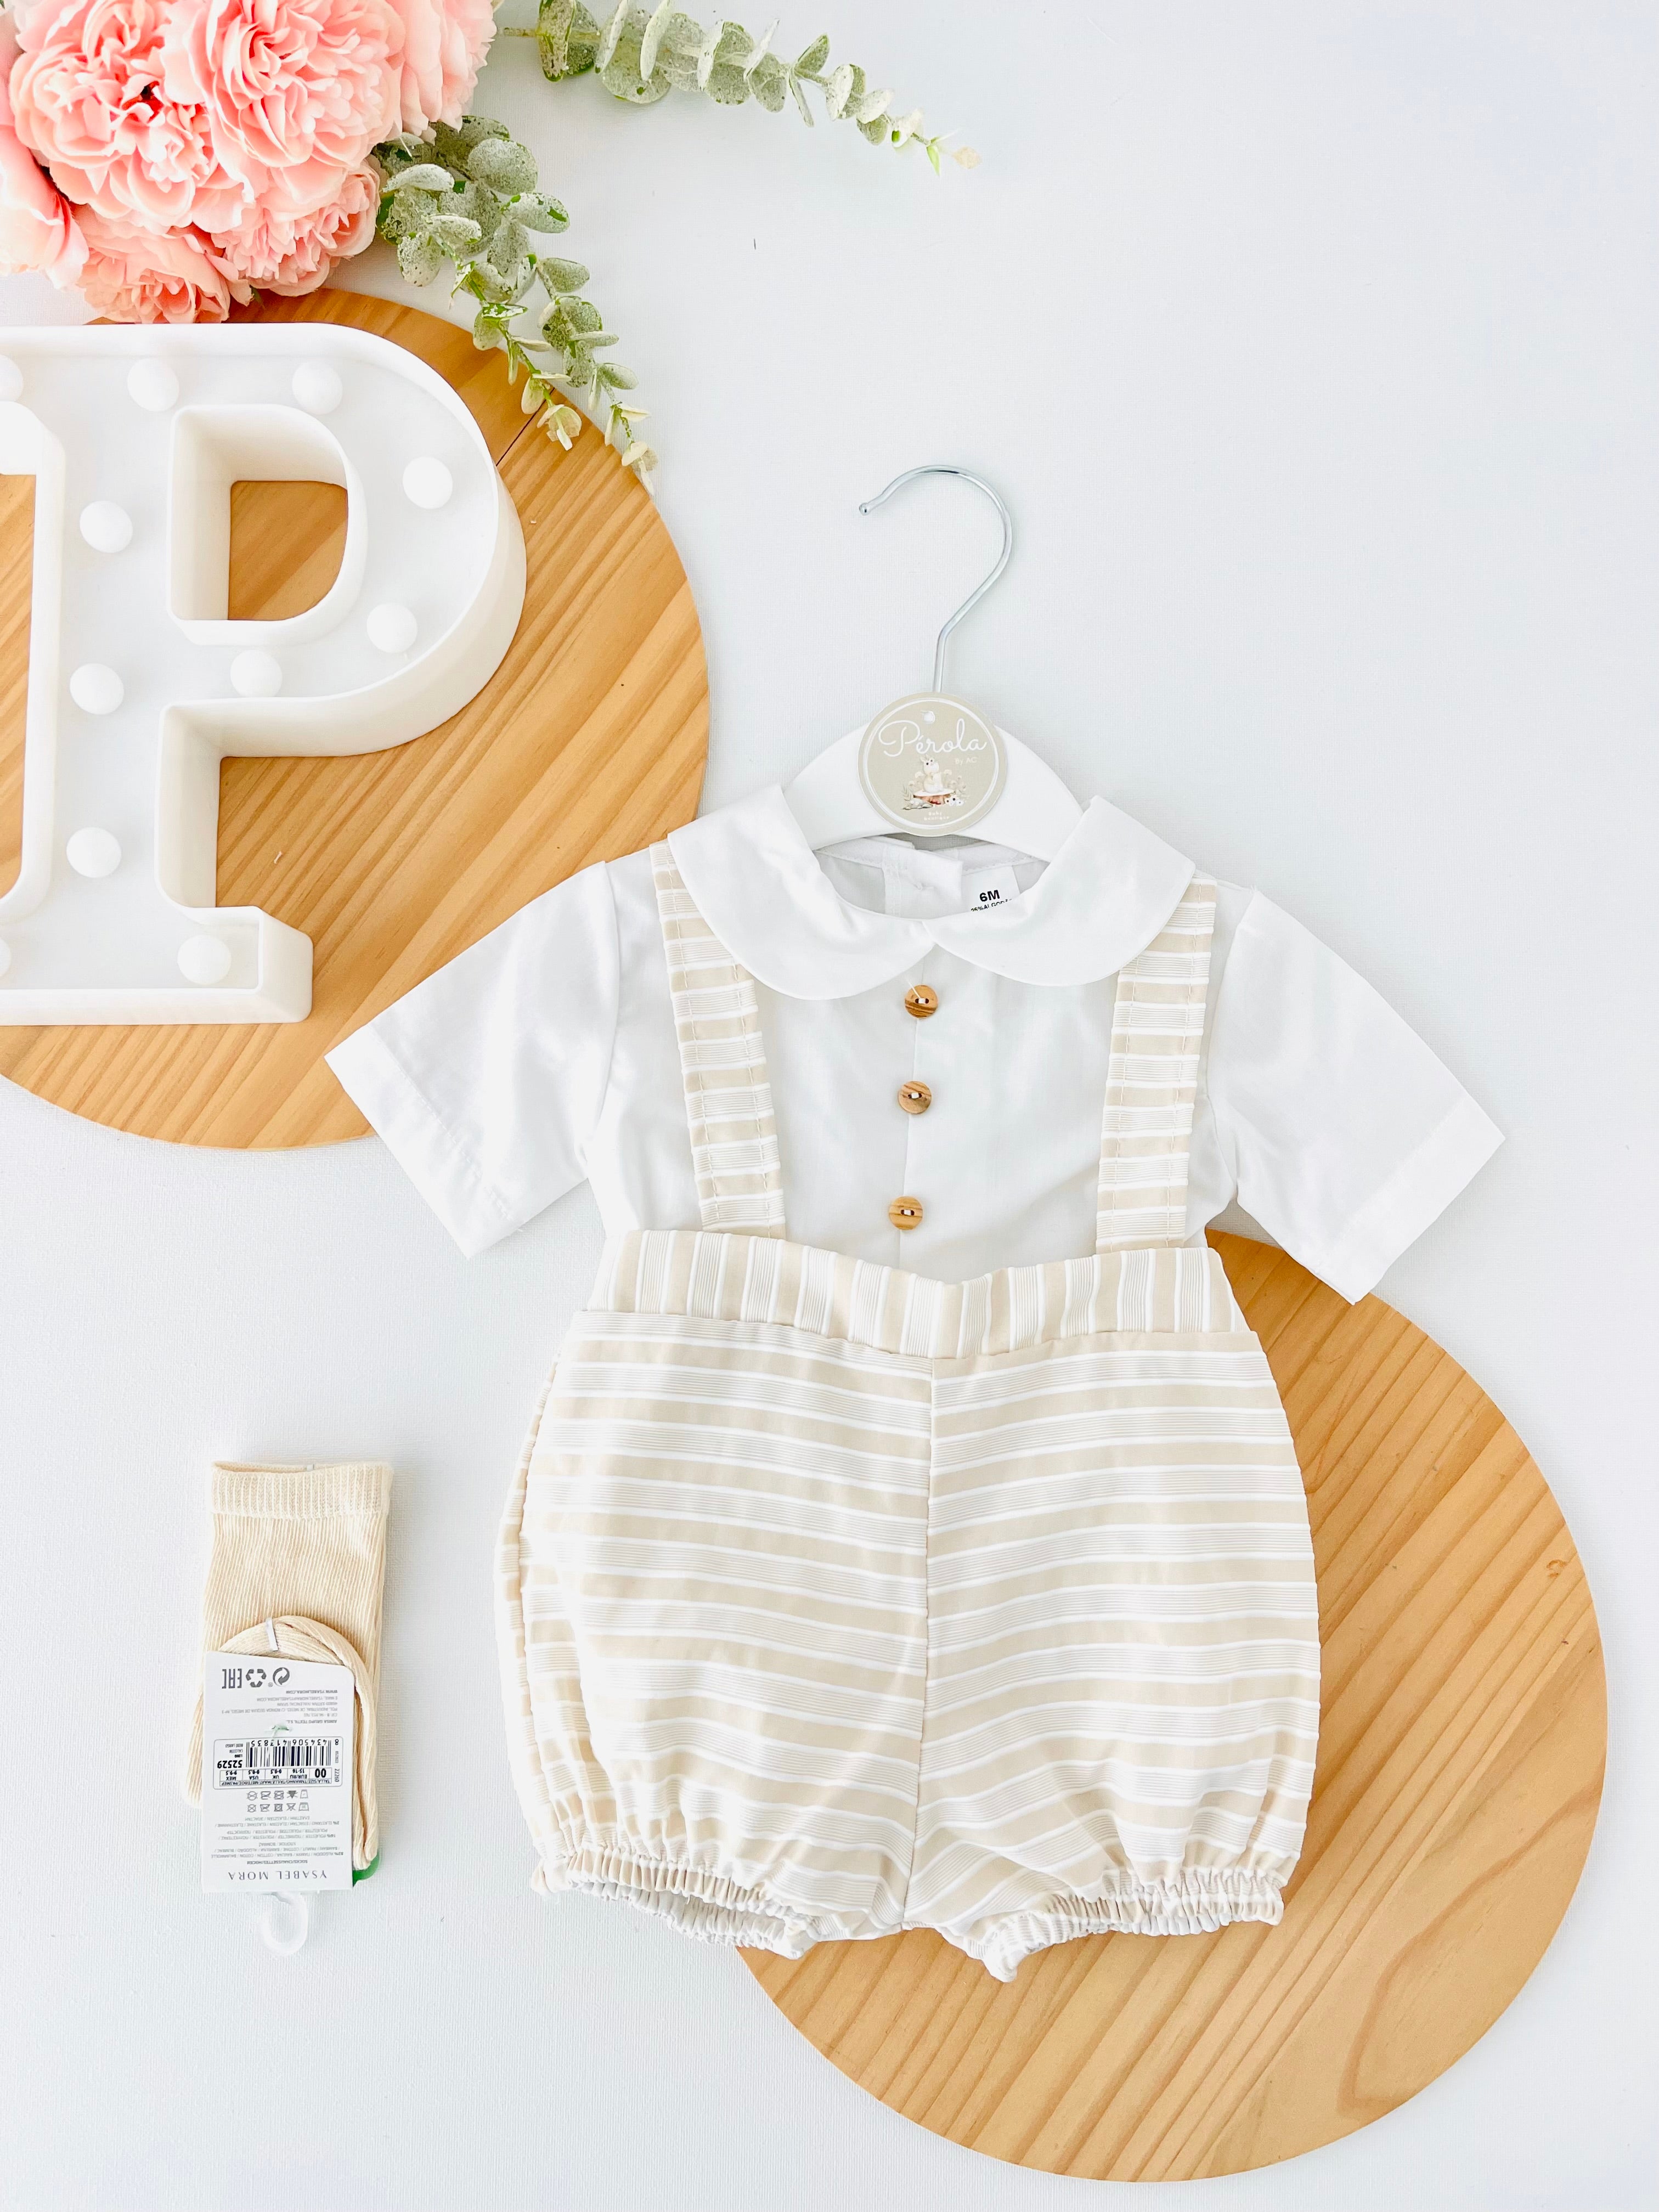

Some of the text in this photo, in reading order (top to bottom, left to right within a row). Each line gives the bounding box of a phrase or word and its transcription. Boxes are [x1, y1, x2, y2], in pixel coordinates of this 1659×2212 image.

[878, 718, 988, 757] Pérola
[979, 889, 1000, 902] 6M
[217, 1760, 242, 1769] 52529
[315, 1768, 326, 1778] 00
[228, 1870, 327, 1880] YSABEL MORA
